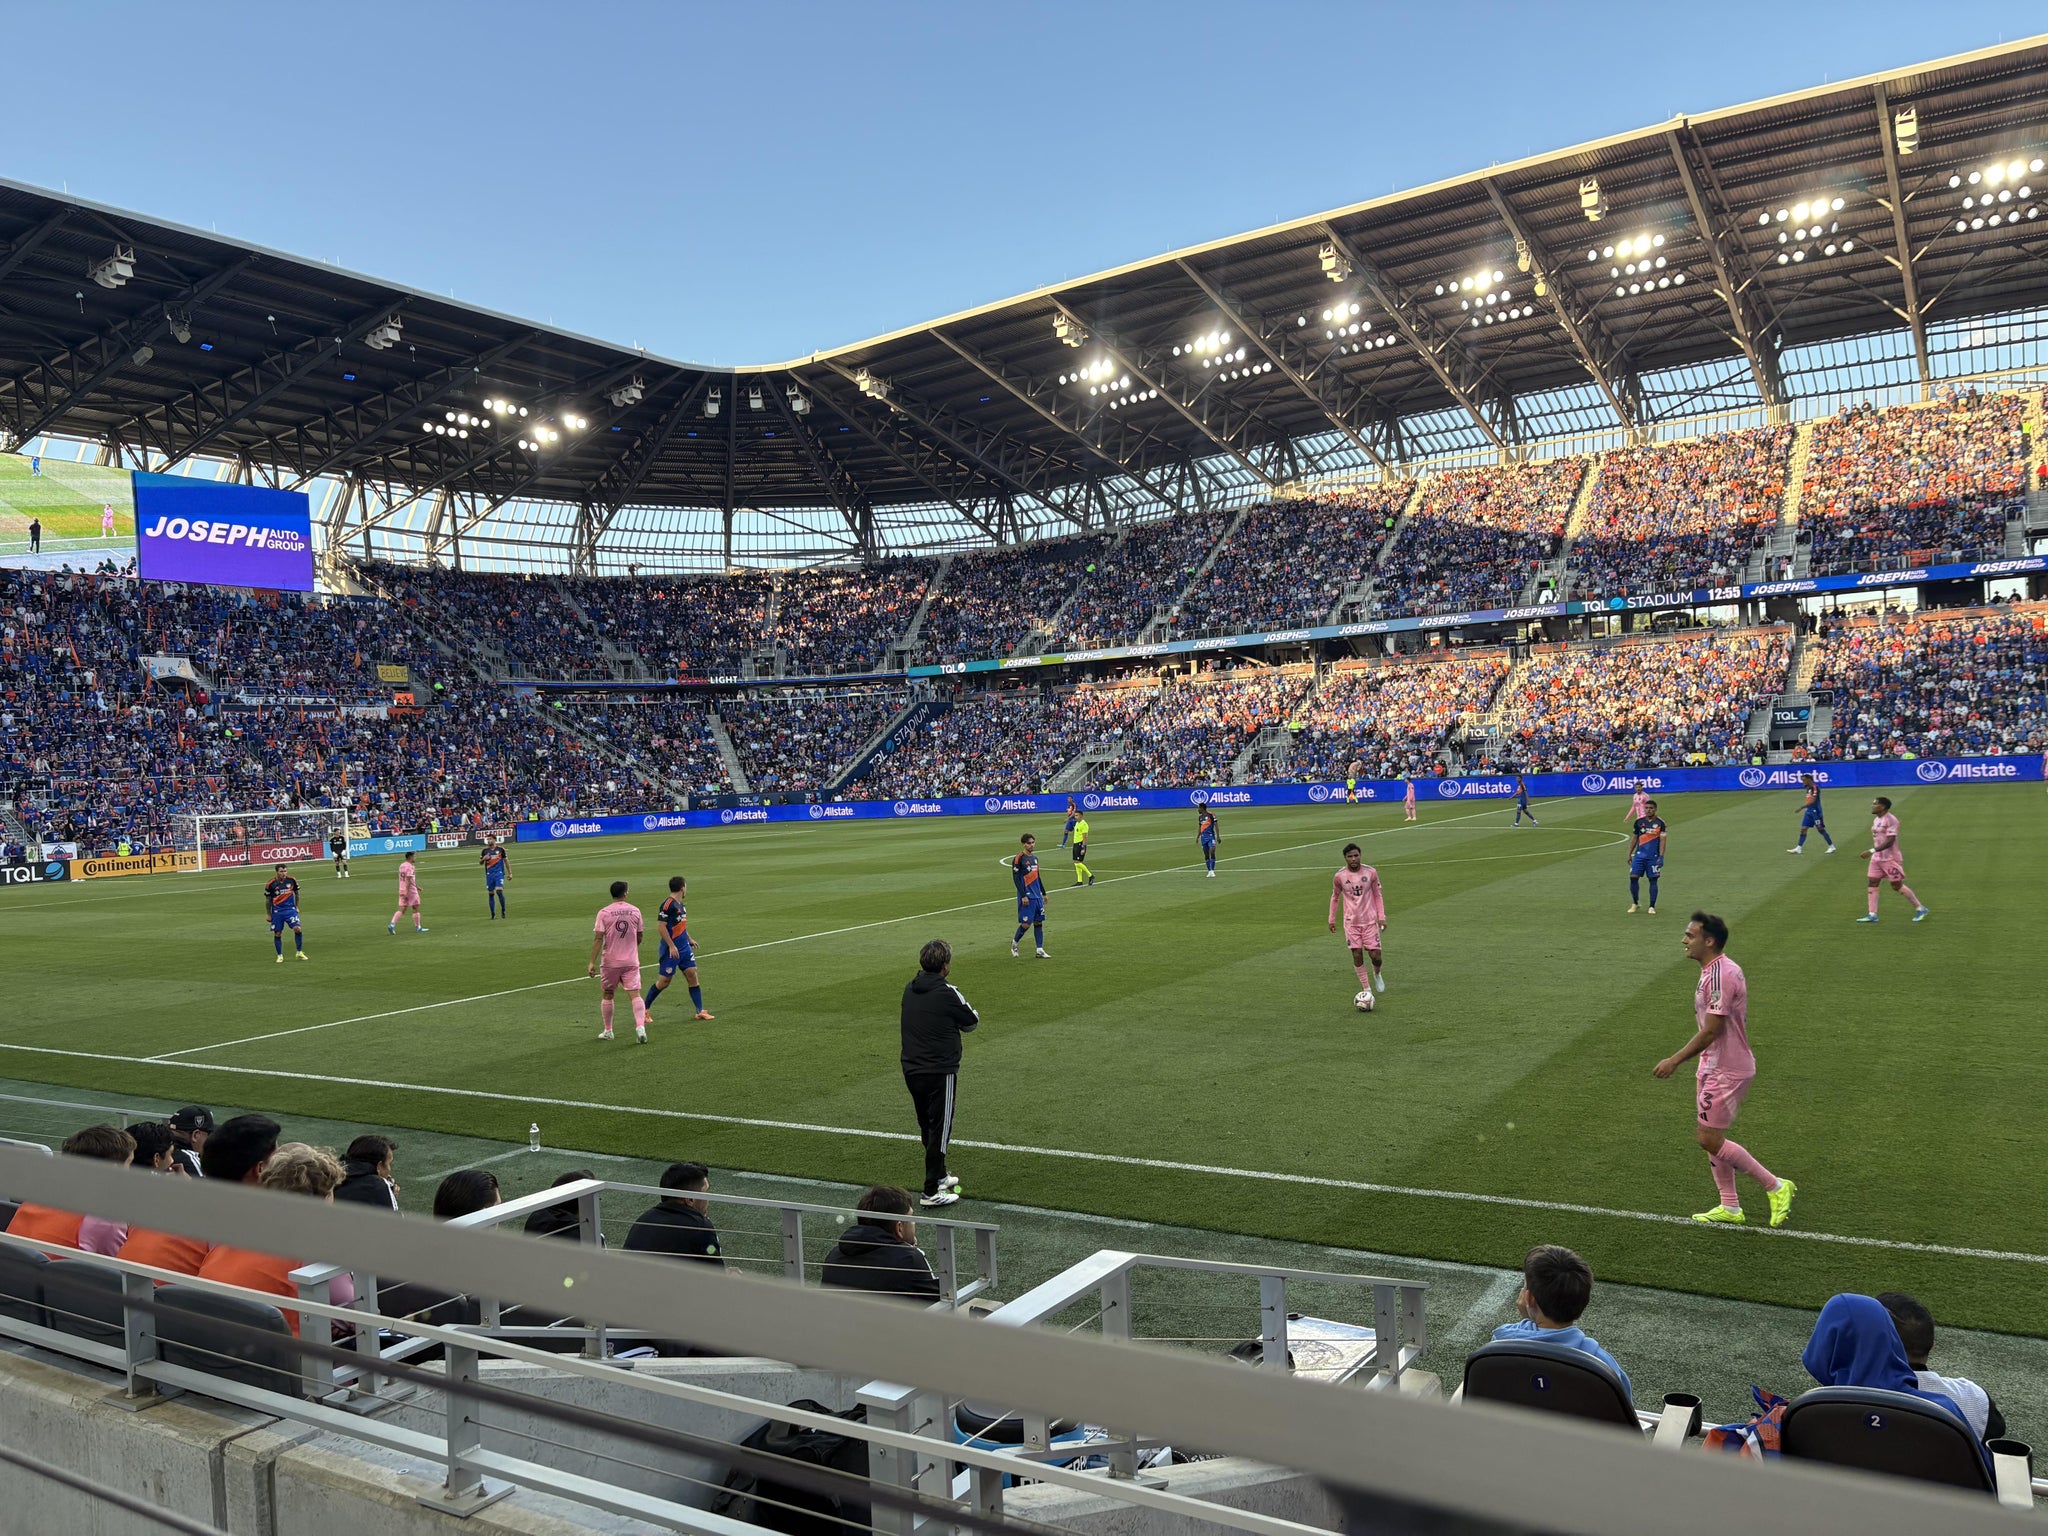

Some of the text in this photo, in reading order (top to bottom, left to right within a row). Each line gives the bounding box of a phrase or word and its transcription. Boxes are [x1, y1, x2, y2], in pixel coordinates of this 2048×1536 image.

[145, 516, 269, 548] JOSEPH
[268, 528, 299, 541] AUTO
[266, 539, 305, 552] GROUP
[1970, 559, 2026, 574] JOSEPH
[1856, 571, 1911, 585] JOSEPH
[1707, 585, 1740, 601] 12:55
[1750, 582, 1801, 596] JOSEPH
[1581, 591, 1693, 612] TQL STADIUM
[1503, 607, 1546, 619] JOSEPH
[1418, 615, 1460, 627] JOSEPH
[1338, 622, 1378, 635] JOSEPH
[1264, 632, 1298, 642] JOSEPH
[1193, 640, 1227, 649] JOSEPH
[1127, 646, 1159, 656] JOSEPH
[1004, 659, 1032, 668] JOSEPH
[1063, 653, 1093, 662] JOSEPH
[940, 664, 958, 674] TQL
[710, 675, 738, 684] LIGHT
[1774, 711, 1799, 721] TQL
[894, 704, 930, 745] STADIUM
[1468, 728, 1488, 737] TQL
[1767, 769, 1829, 784] Allstte
[1948, 763, 2017, 778] Allstate
[1462, 782, 1512, 795] Allstate
[1100, 796, 1138, 806] Allstate
[1209, 791, 1251, 803] Allstate
[909, 803, 942, 813] Allstate
[1001, 800, 1036, 810] Allstate
[733, 810, 768, 821] Allstate
[823, 807, 854, 817] Allstate
[657, 815, 686, 827] Allstate
[567, 822, 601, 835] Allstate
[428, 831, 468, 843] DISCOUNT
[350, 842, 369, 851] AT&T
[396, 839, 413, 849] AT&T
[218, 850, 250, 863] Audi
[83, 856, 157, 876] Continental
[166, 853, 197, 867] Tire
[1, 866, 43, 884] TQL
[615, 920, 629, 939] 9
[1537, 1377, 1544, 1388] 1
[1871, 1415, 1881, 1427] 2
